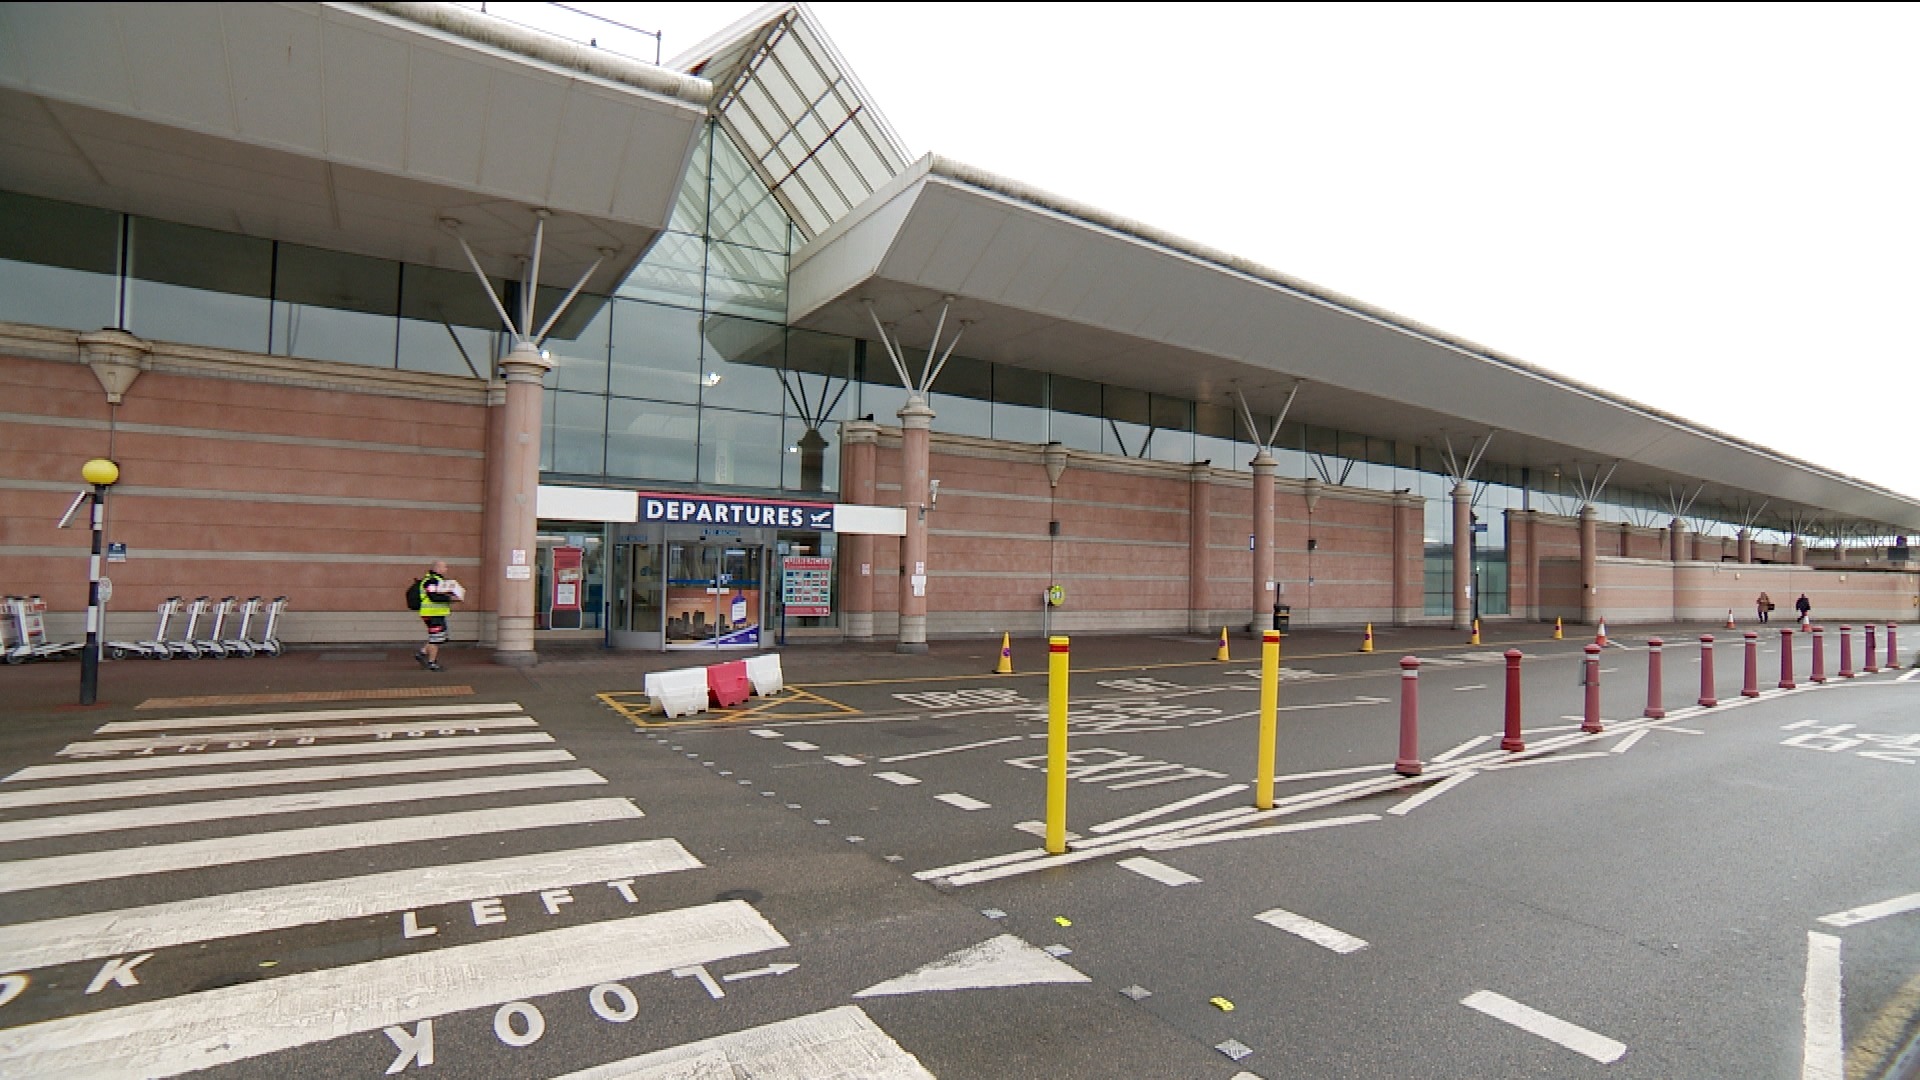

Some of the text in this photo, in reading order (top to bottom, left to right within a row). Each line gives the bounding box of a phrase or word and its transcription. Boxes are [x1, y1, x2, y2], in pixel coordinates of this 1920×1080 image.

[646, 499, 803, 526] DEPARTURES
[1004, 747, 1229, 790] EXIT
[403, 879, 639, 939] LEFT
[383, 964, 726, 1075] LOOK
